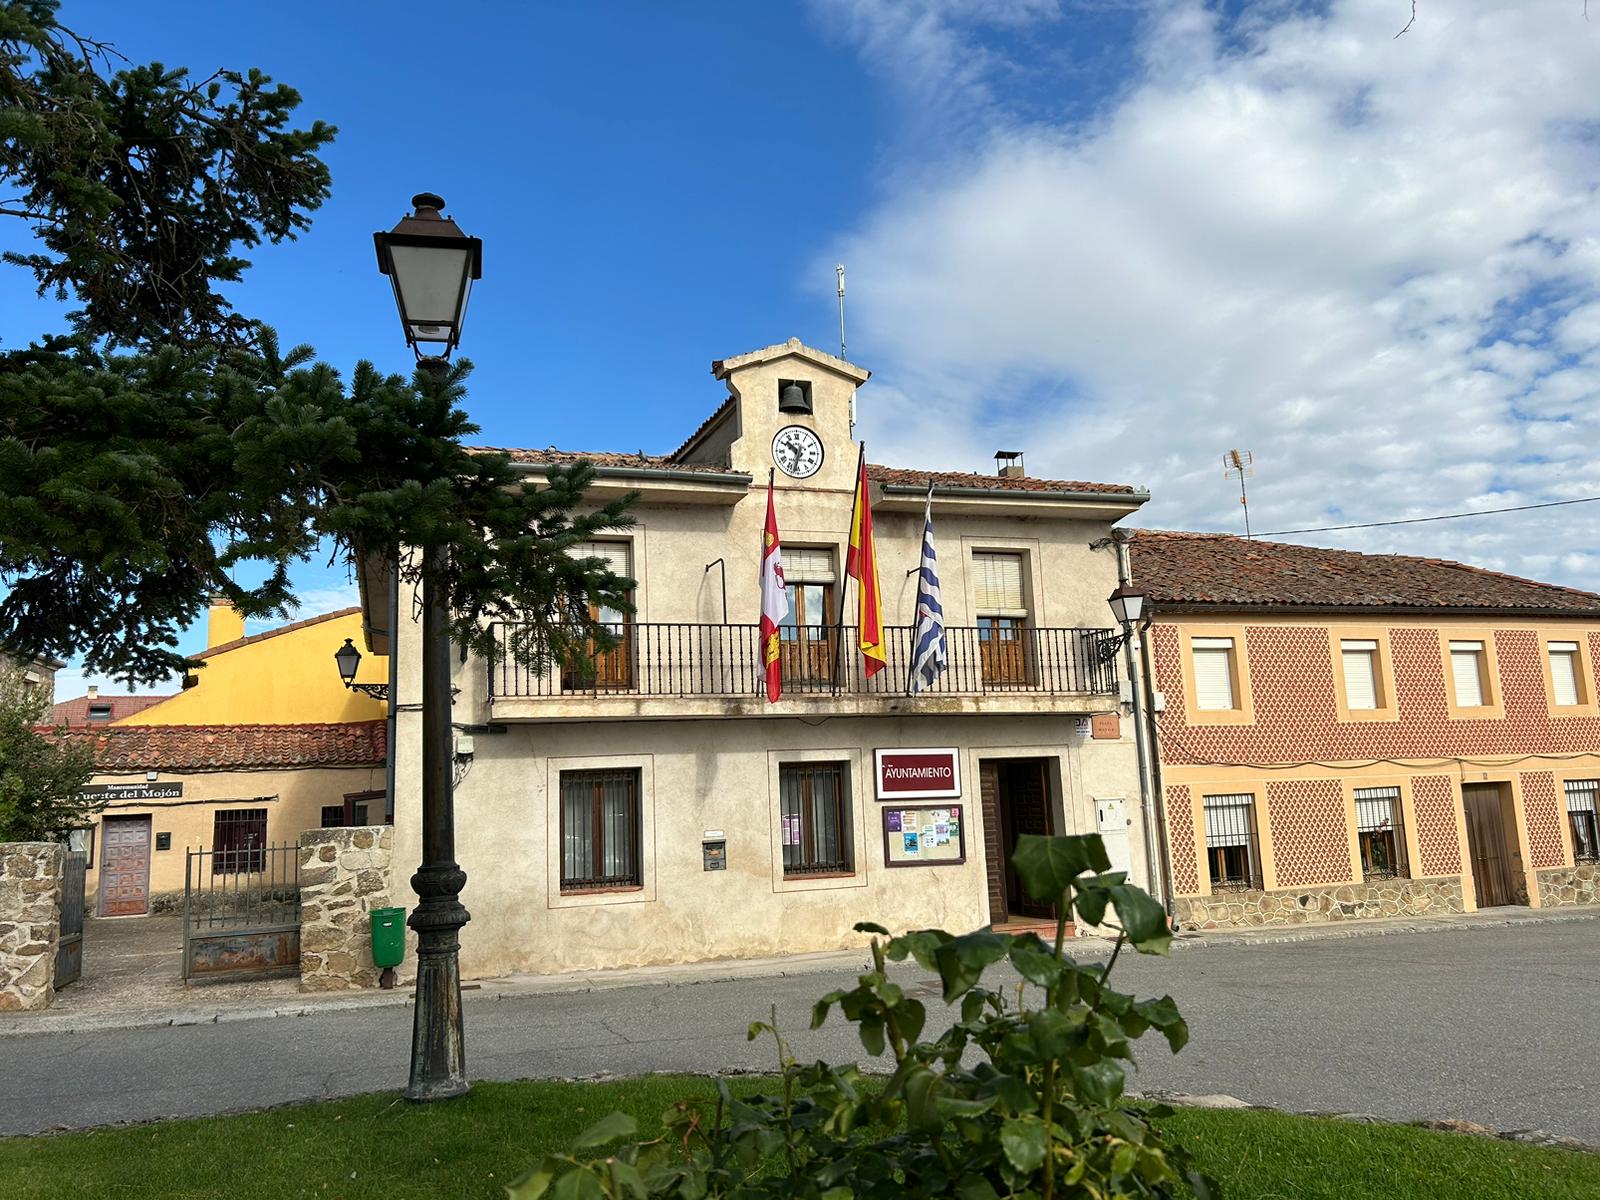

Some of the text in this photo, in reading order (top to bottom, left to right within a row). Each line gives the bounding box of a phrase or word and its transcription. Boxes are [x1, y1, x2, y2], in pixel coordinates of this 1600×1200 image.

[885, 767, 952, 779] AYUNTAMIENTO
[79, 791, 117, 800] uete
[120, 790, 138, 799] del
[141, 788, 180, 799] Mojón
